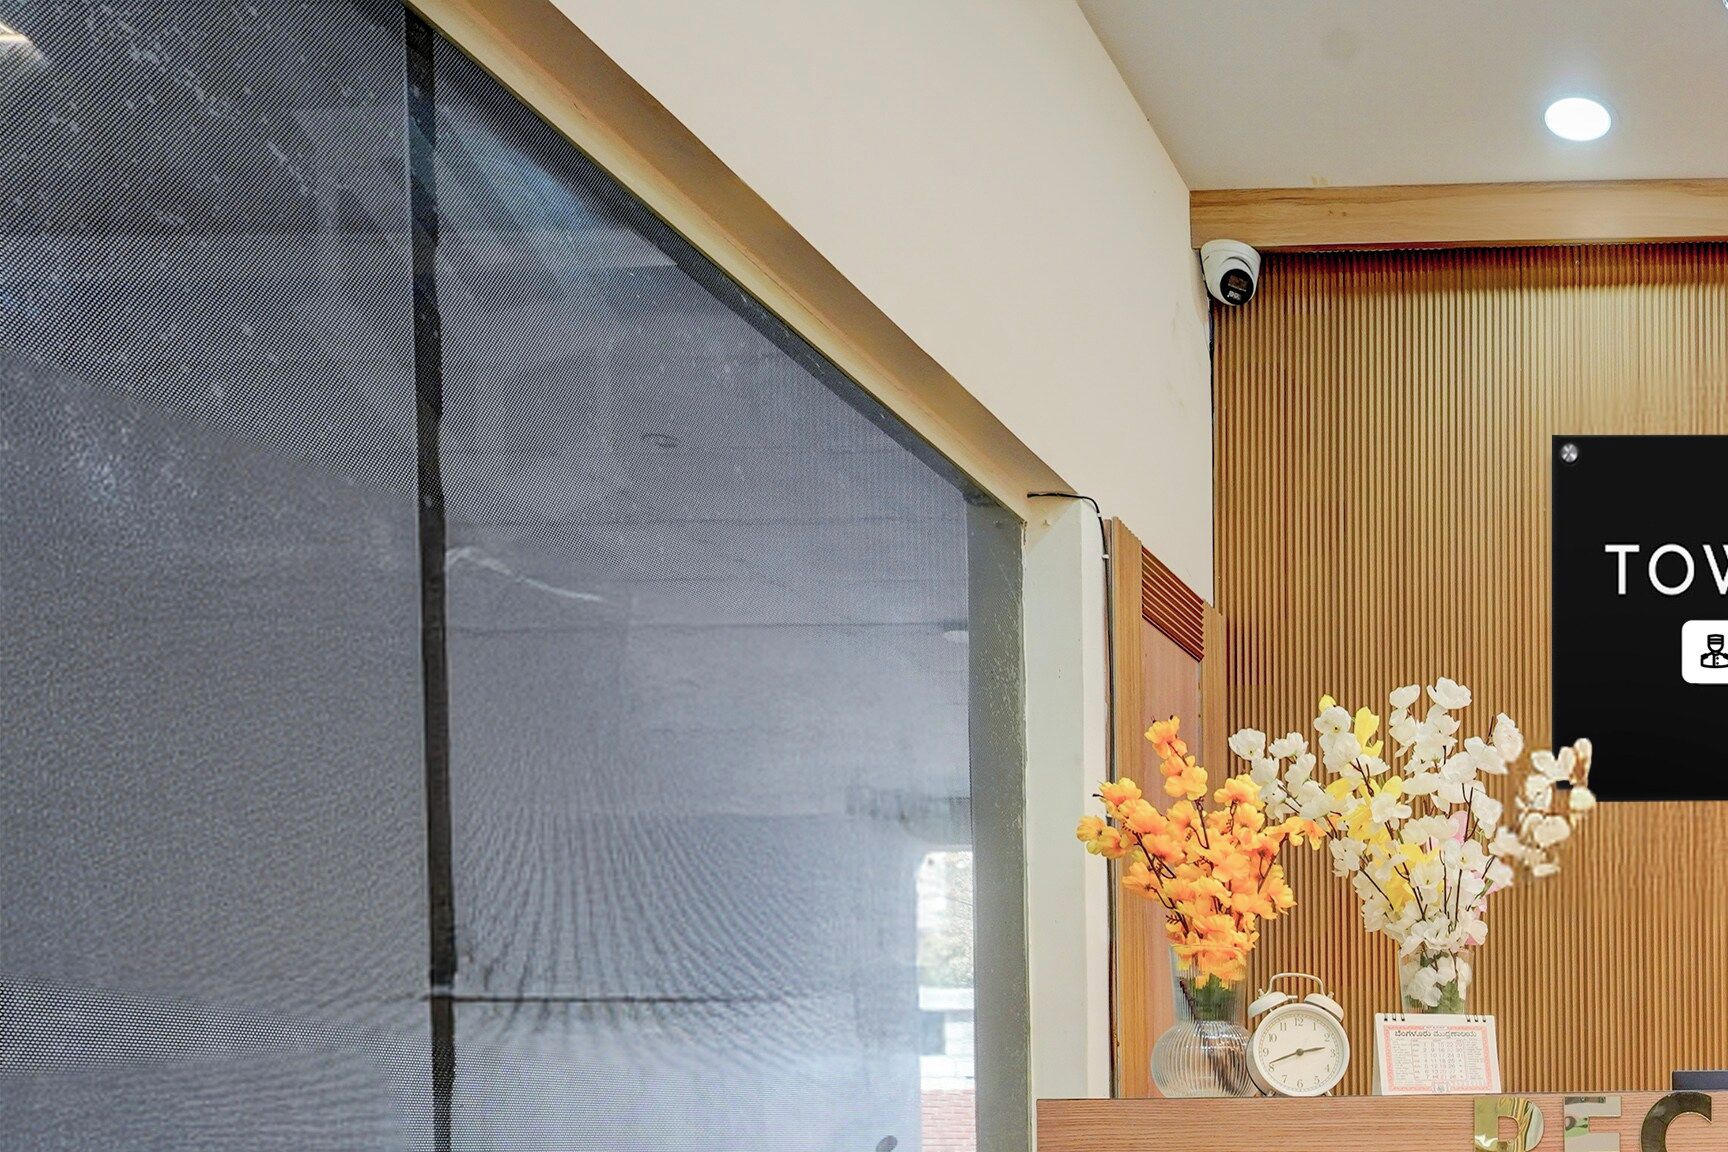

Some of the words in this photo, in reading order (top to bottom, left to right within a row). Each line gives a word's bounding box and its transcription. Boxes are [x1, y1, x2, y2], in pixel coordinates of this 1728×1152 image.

[1294, 1017, 1304, 1026] 12
[1280, 1022, 1287, 1031] 11
[1313, 1022, 1316, 1031] 1
[1268, 1033, 1277, 1042] 10
[1323, 1033, 1331, 1042] 2
[1262, 1048, 1269, 1057] 9
[1329, 1048, 1336, 1058] 3
[1268, 1063, 1275, 1072] 8
[1324, 1064, 1330, 1073] 4
[1281, 1074, 1288, 1084] 7
[1296, 1079, 1304, 1088] 6
[1314, 1075, 1320, 1084] 5
